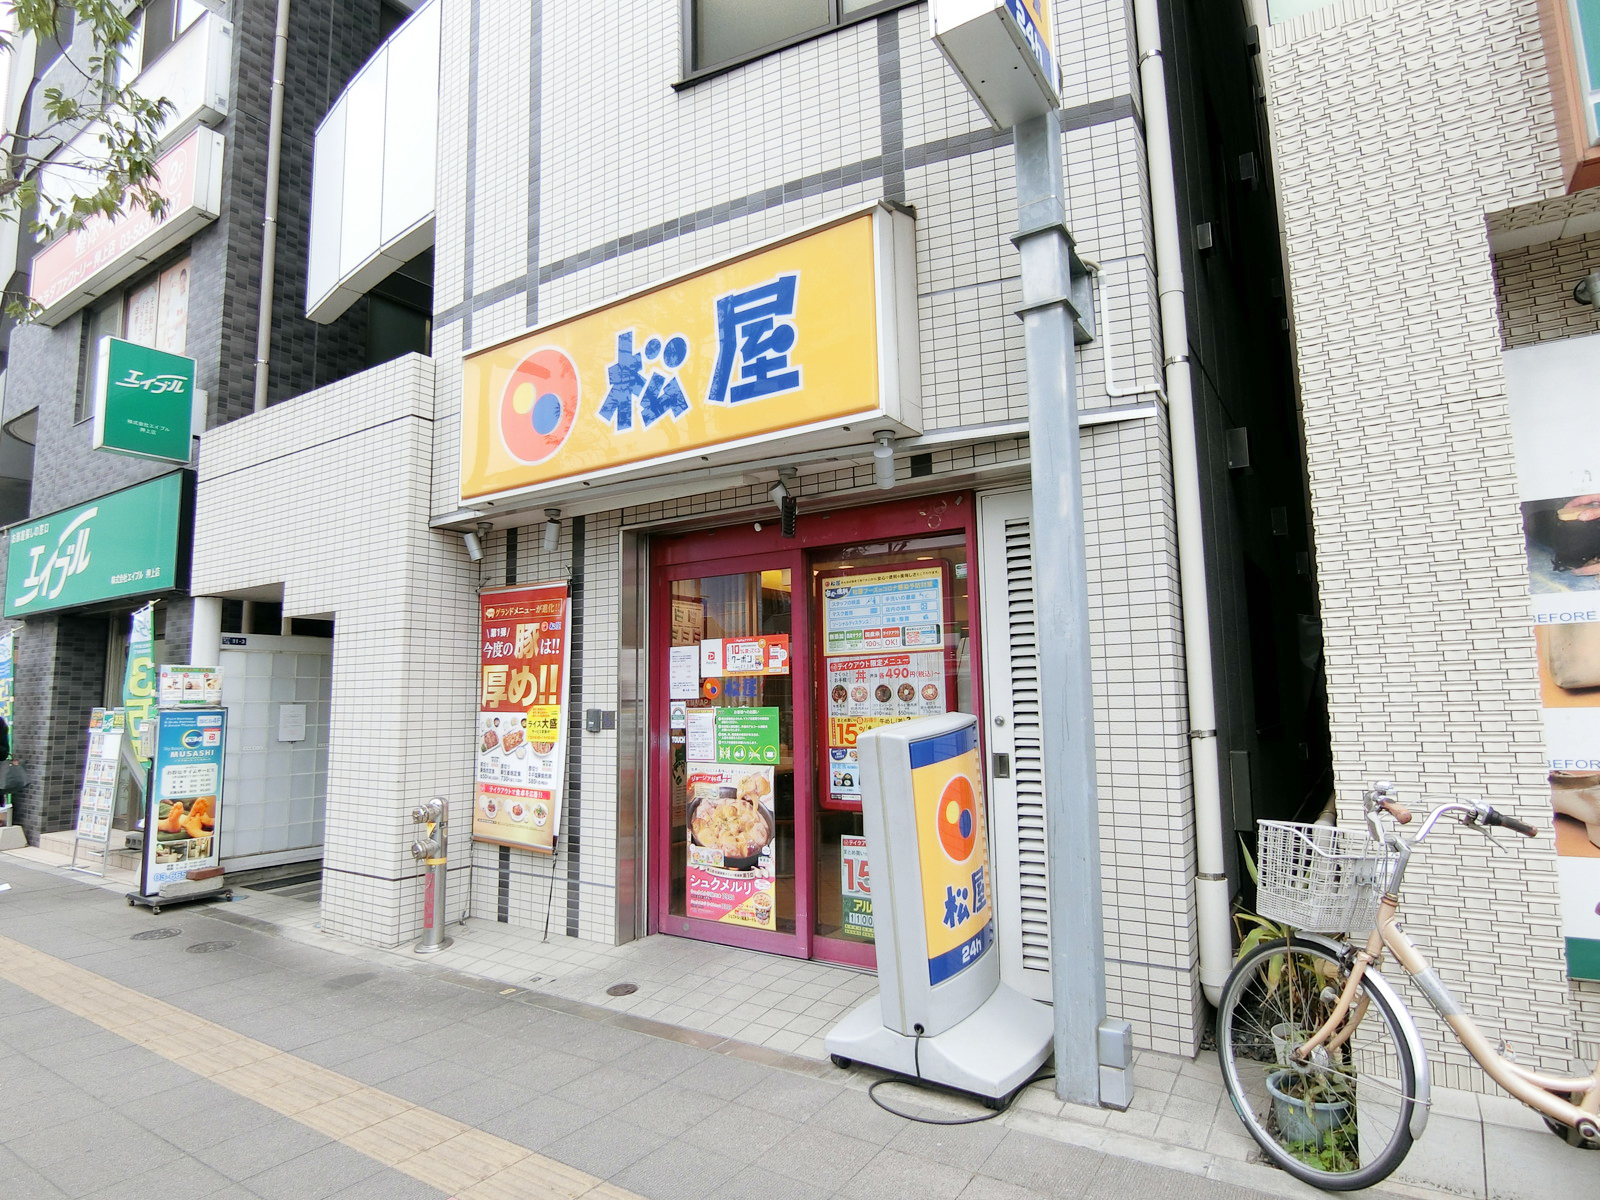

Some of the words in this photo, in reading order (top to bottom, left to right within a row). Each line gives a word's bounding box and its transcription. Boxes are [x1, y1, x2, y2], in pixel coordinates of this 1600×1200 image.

[597, 273, 801, 432] 松屋
[115, 369, 189, 394] エイブル
[126, 419, 171, 432] 株式会社エイブル
[14, 506, 99, 607] エイブル
[111, 571, 144, 585] 株式会社エイブル
[495, 603, 561, 617] グランドメニューが進化!!
[483, 623, 560, 659] 今度の豚は!!
[837, 658, 909, 670] テイクアウト限定メニュー
[481, 664, 559, 708] 厚め!!
[856, 670, 866, 683] 丼
[528, 718, 558, 729] ライス大盛
[170, 749, 214, 758] MUSASHI
[690, 874, 752, 896] シュクメルリ
[942, 864, 987, 929] 松屋
[961, 937, 982, 963] 24h
